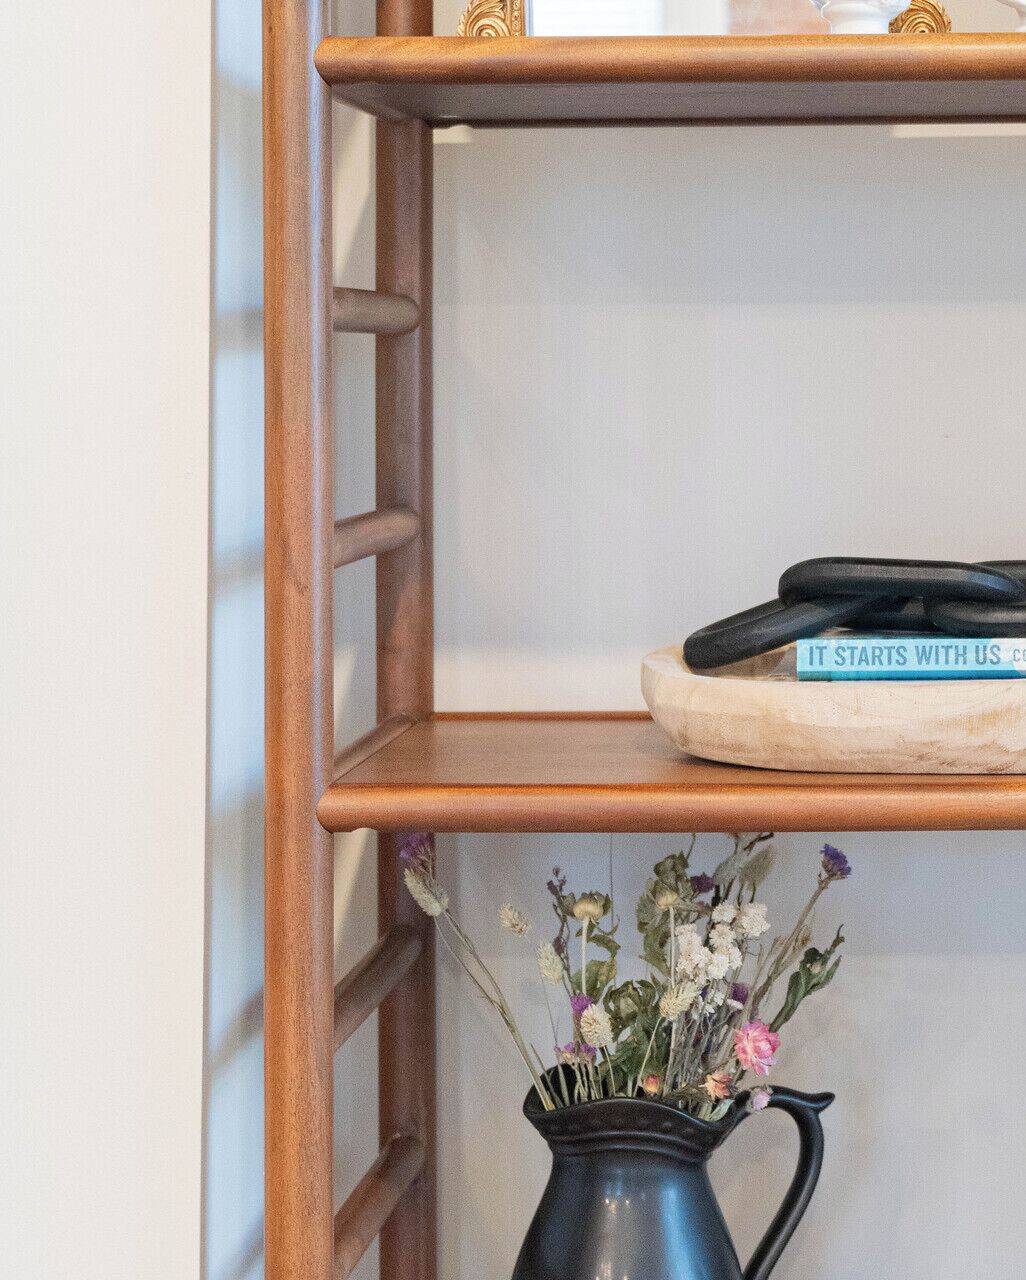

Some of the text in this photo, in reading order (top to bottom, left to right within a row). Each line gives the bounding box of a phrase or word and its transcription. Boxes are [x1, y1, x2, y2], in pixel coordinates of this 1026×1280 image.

[808, 644, 1001, 666] IT STARTS WITH US
